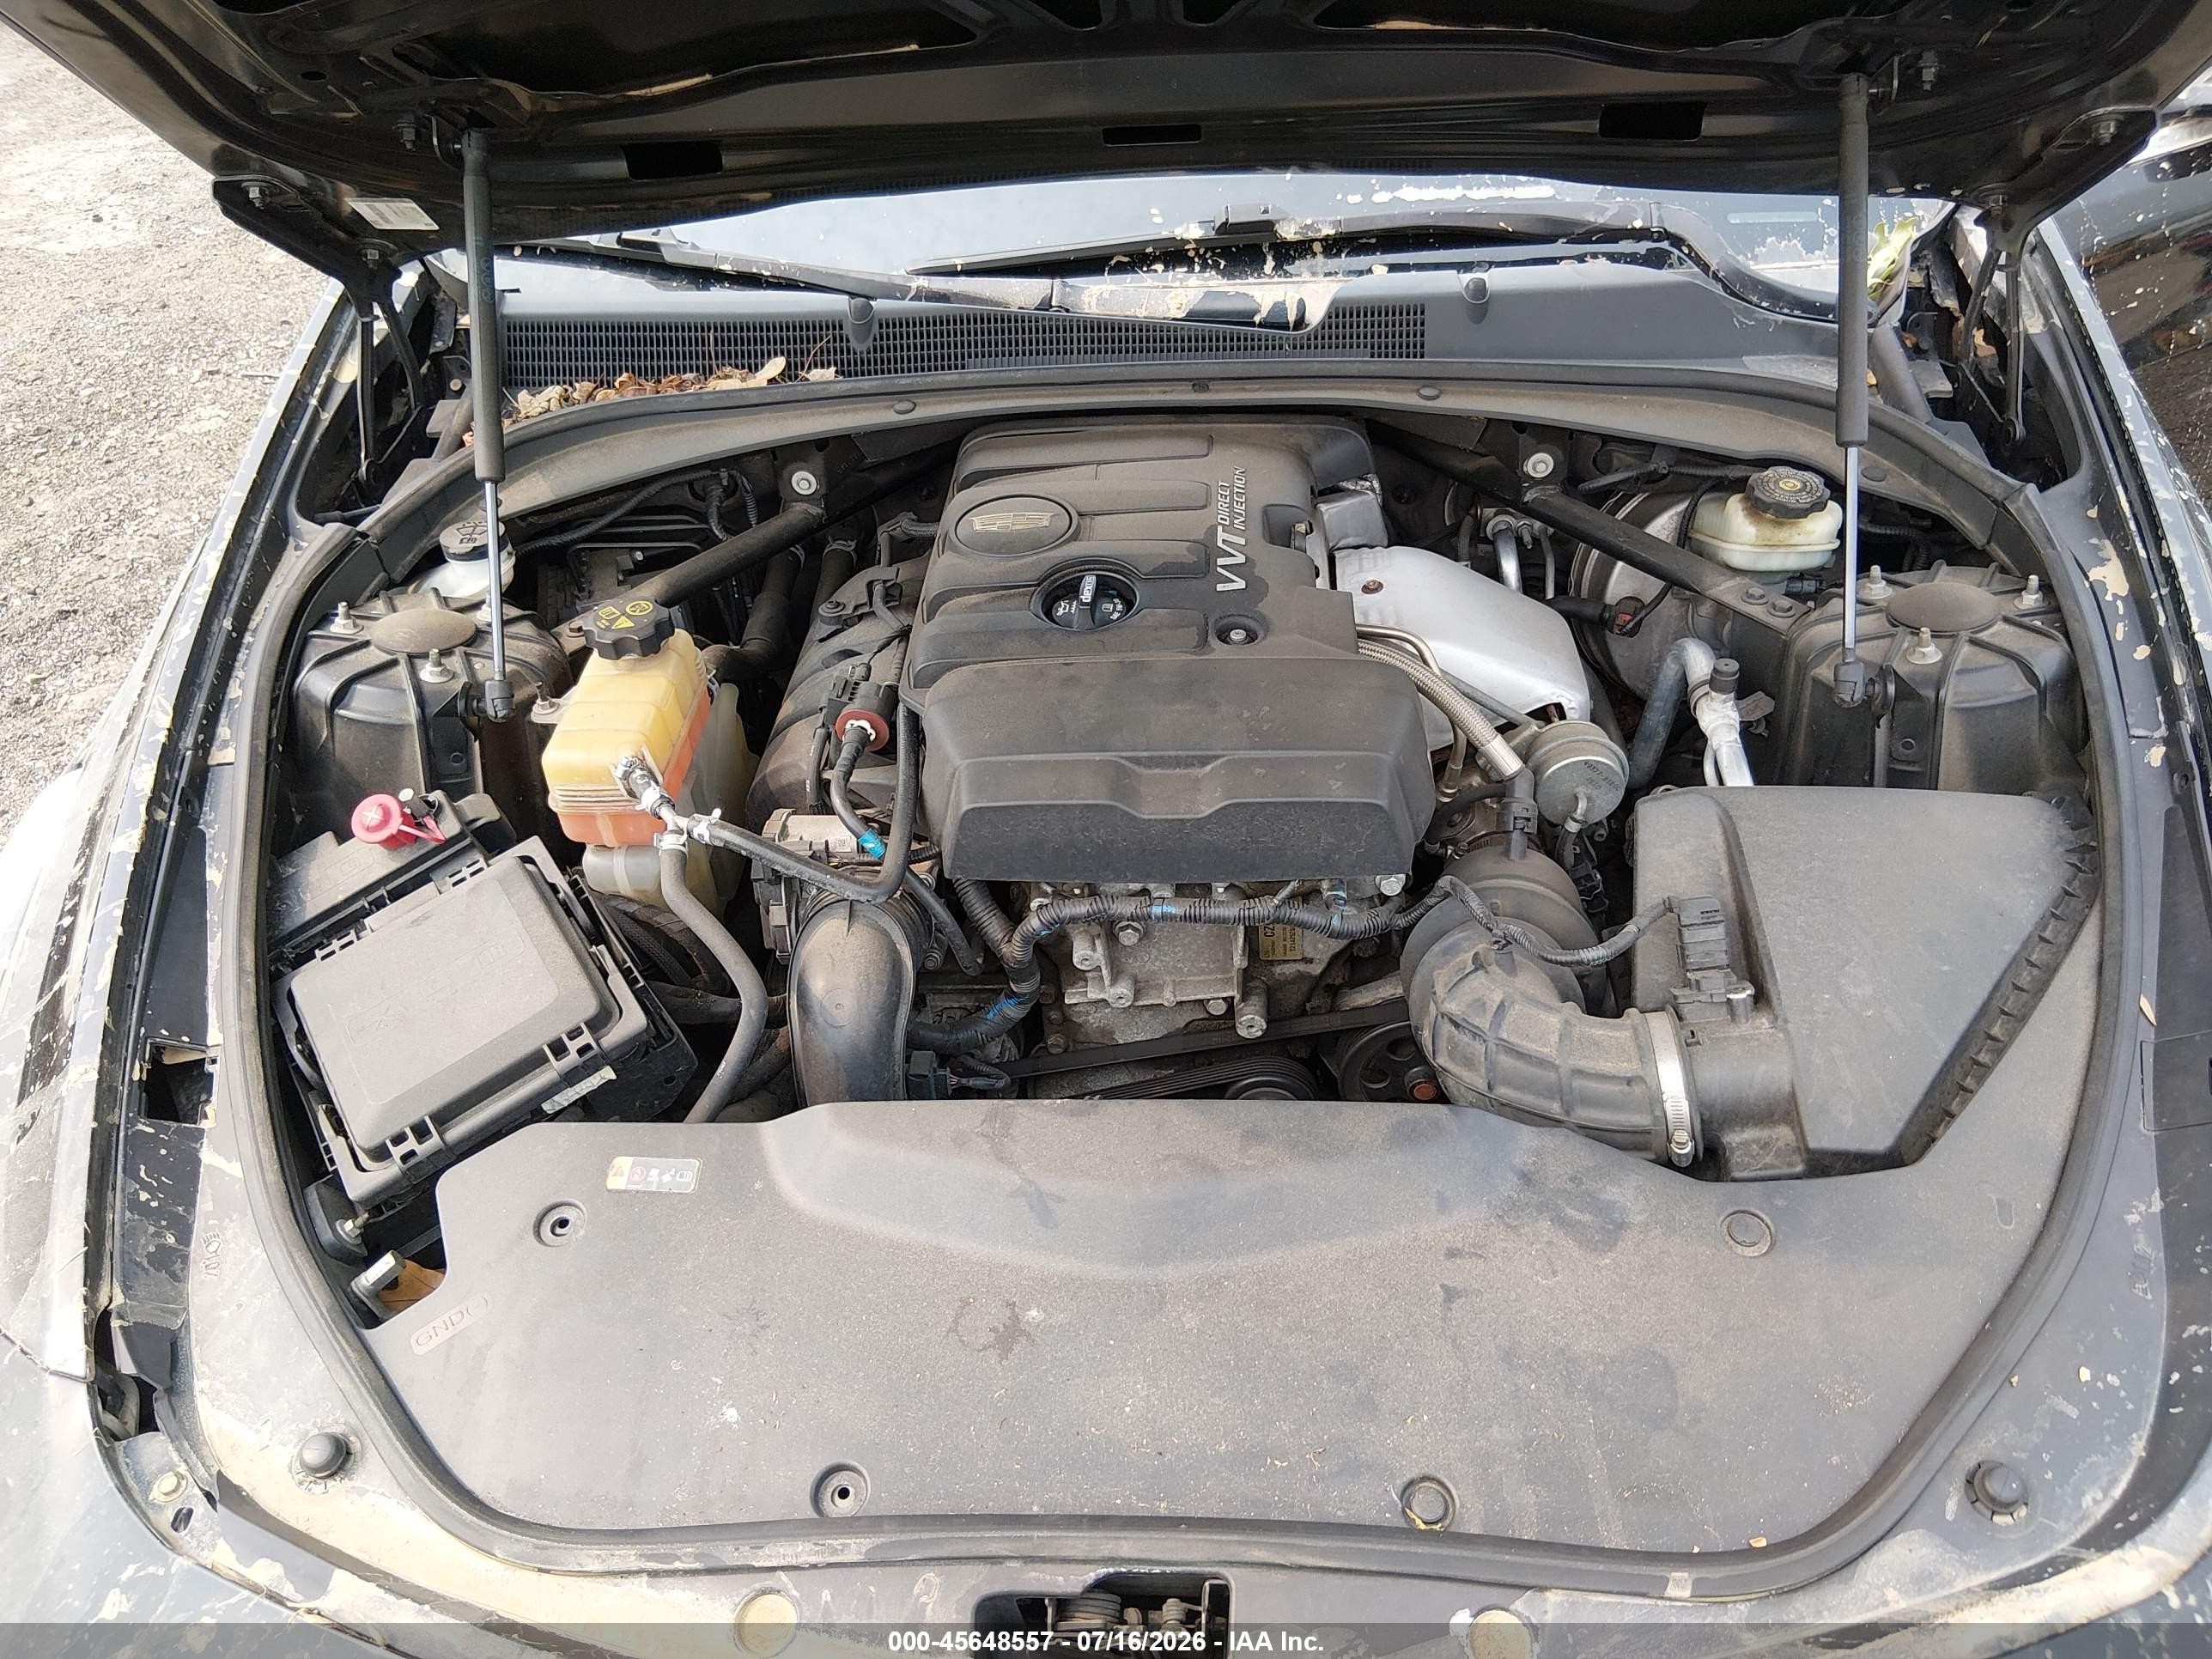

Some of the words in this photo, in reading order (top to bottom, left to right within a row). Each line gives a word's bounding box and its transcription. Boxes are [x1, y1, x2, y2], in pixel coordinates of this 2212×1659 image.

[1217, 480, 1231, 526] DIRECT
[1233, 466, 1246, 531] INJECTION
[1216, 525, 1246, 592] VVT
